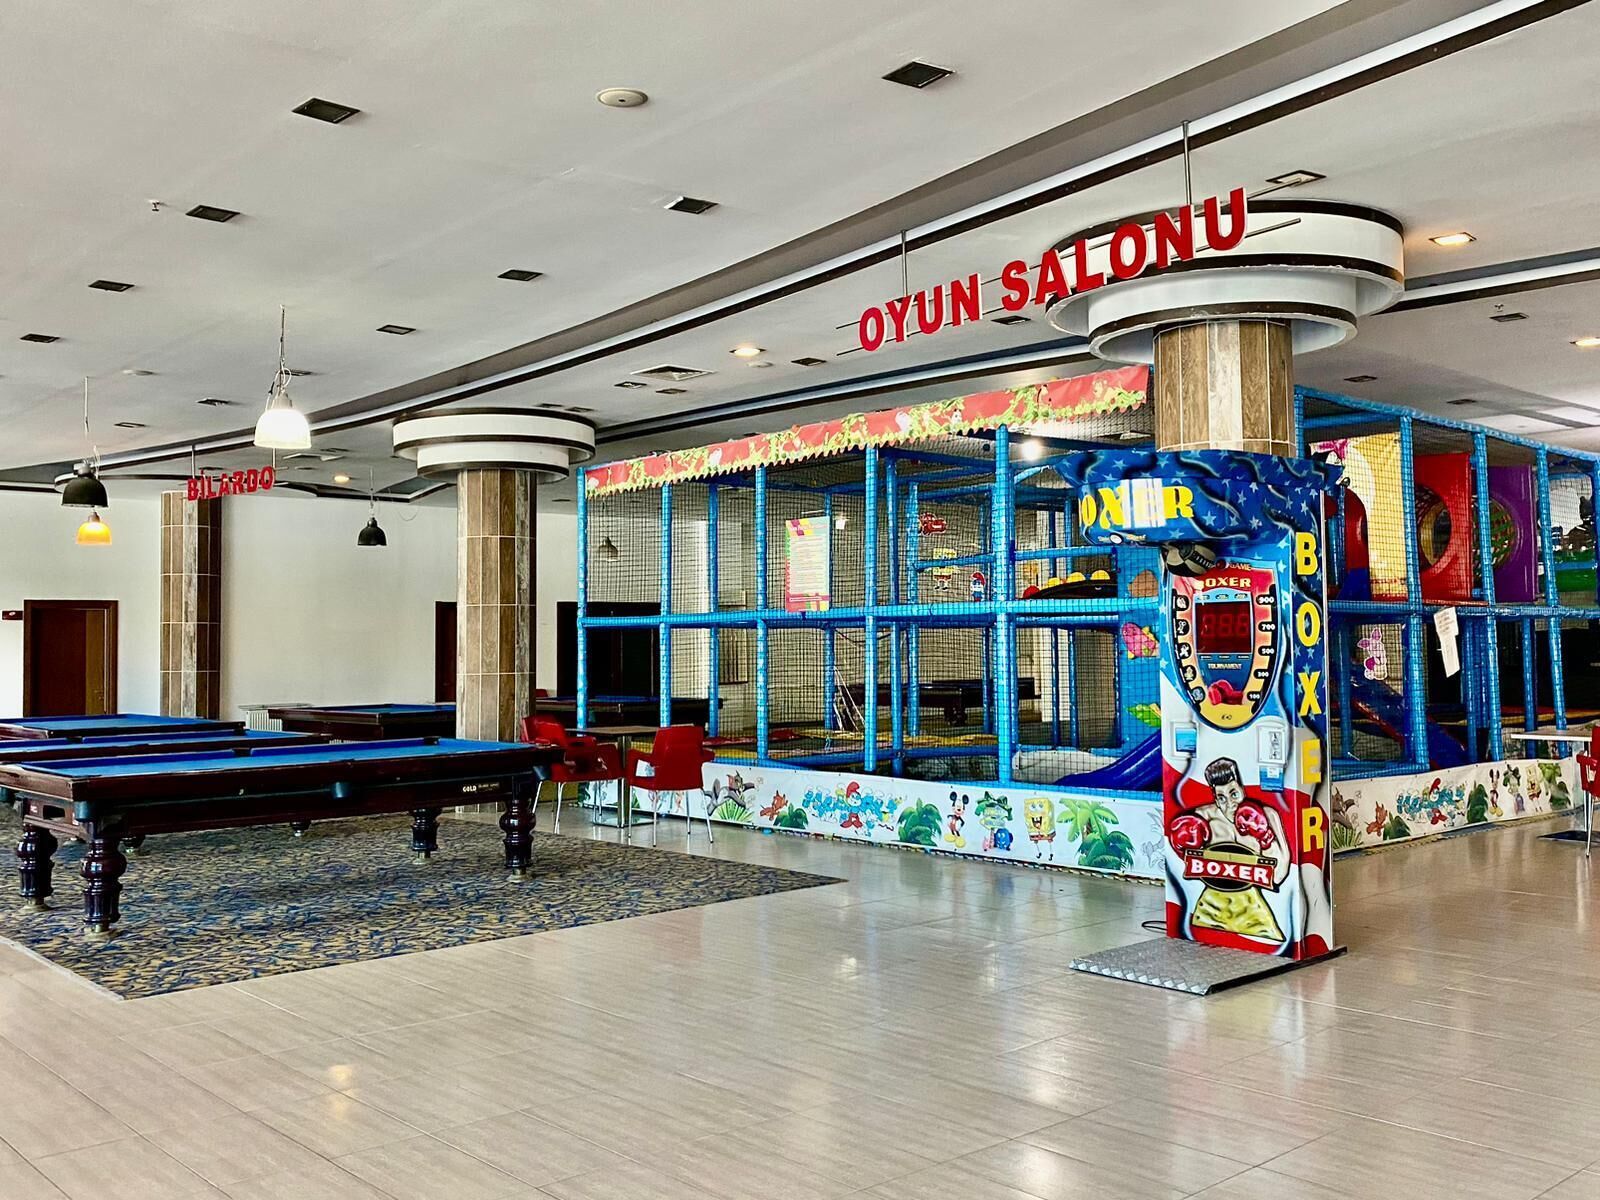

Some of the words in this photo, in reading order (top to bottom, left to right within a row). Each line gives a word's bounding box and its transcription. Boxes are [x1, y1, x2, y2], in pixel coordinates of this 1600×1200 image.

[859, 273, 983, 352] OYUN
[1001, 187, 1248, 312] SALONU
[1258, 596, 1275, 604] 900
[1261, 623, 1276, 631] 700
[1249, 692, 1261, 700] 100
[1296, 531, 1324, 853] BOXER
[462, 784, 477, 793] GOLD
[1190, 858, 1270, 884] BOXER
